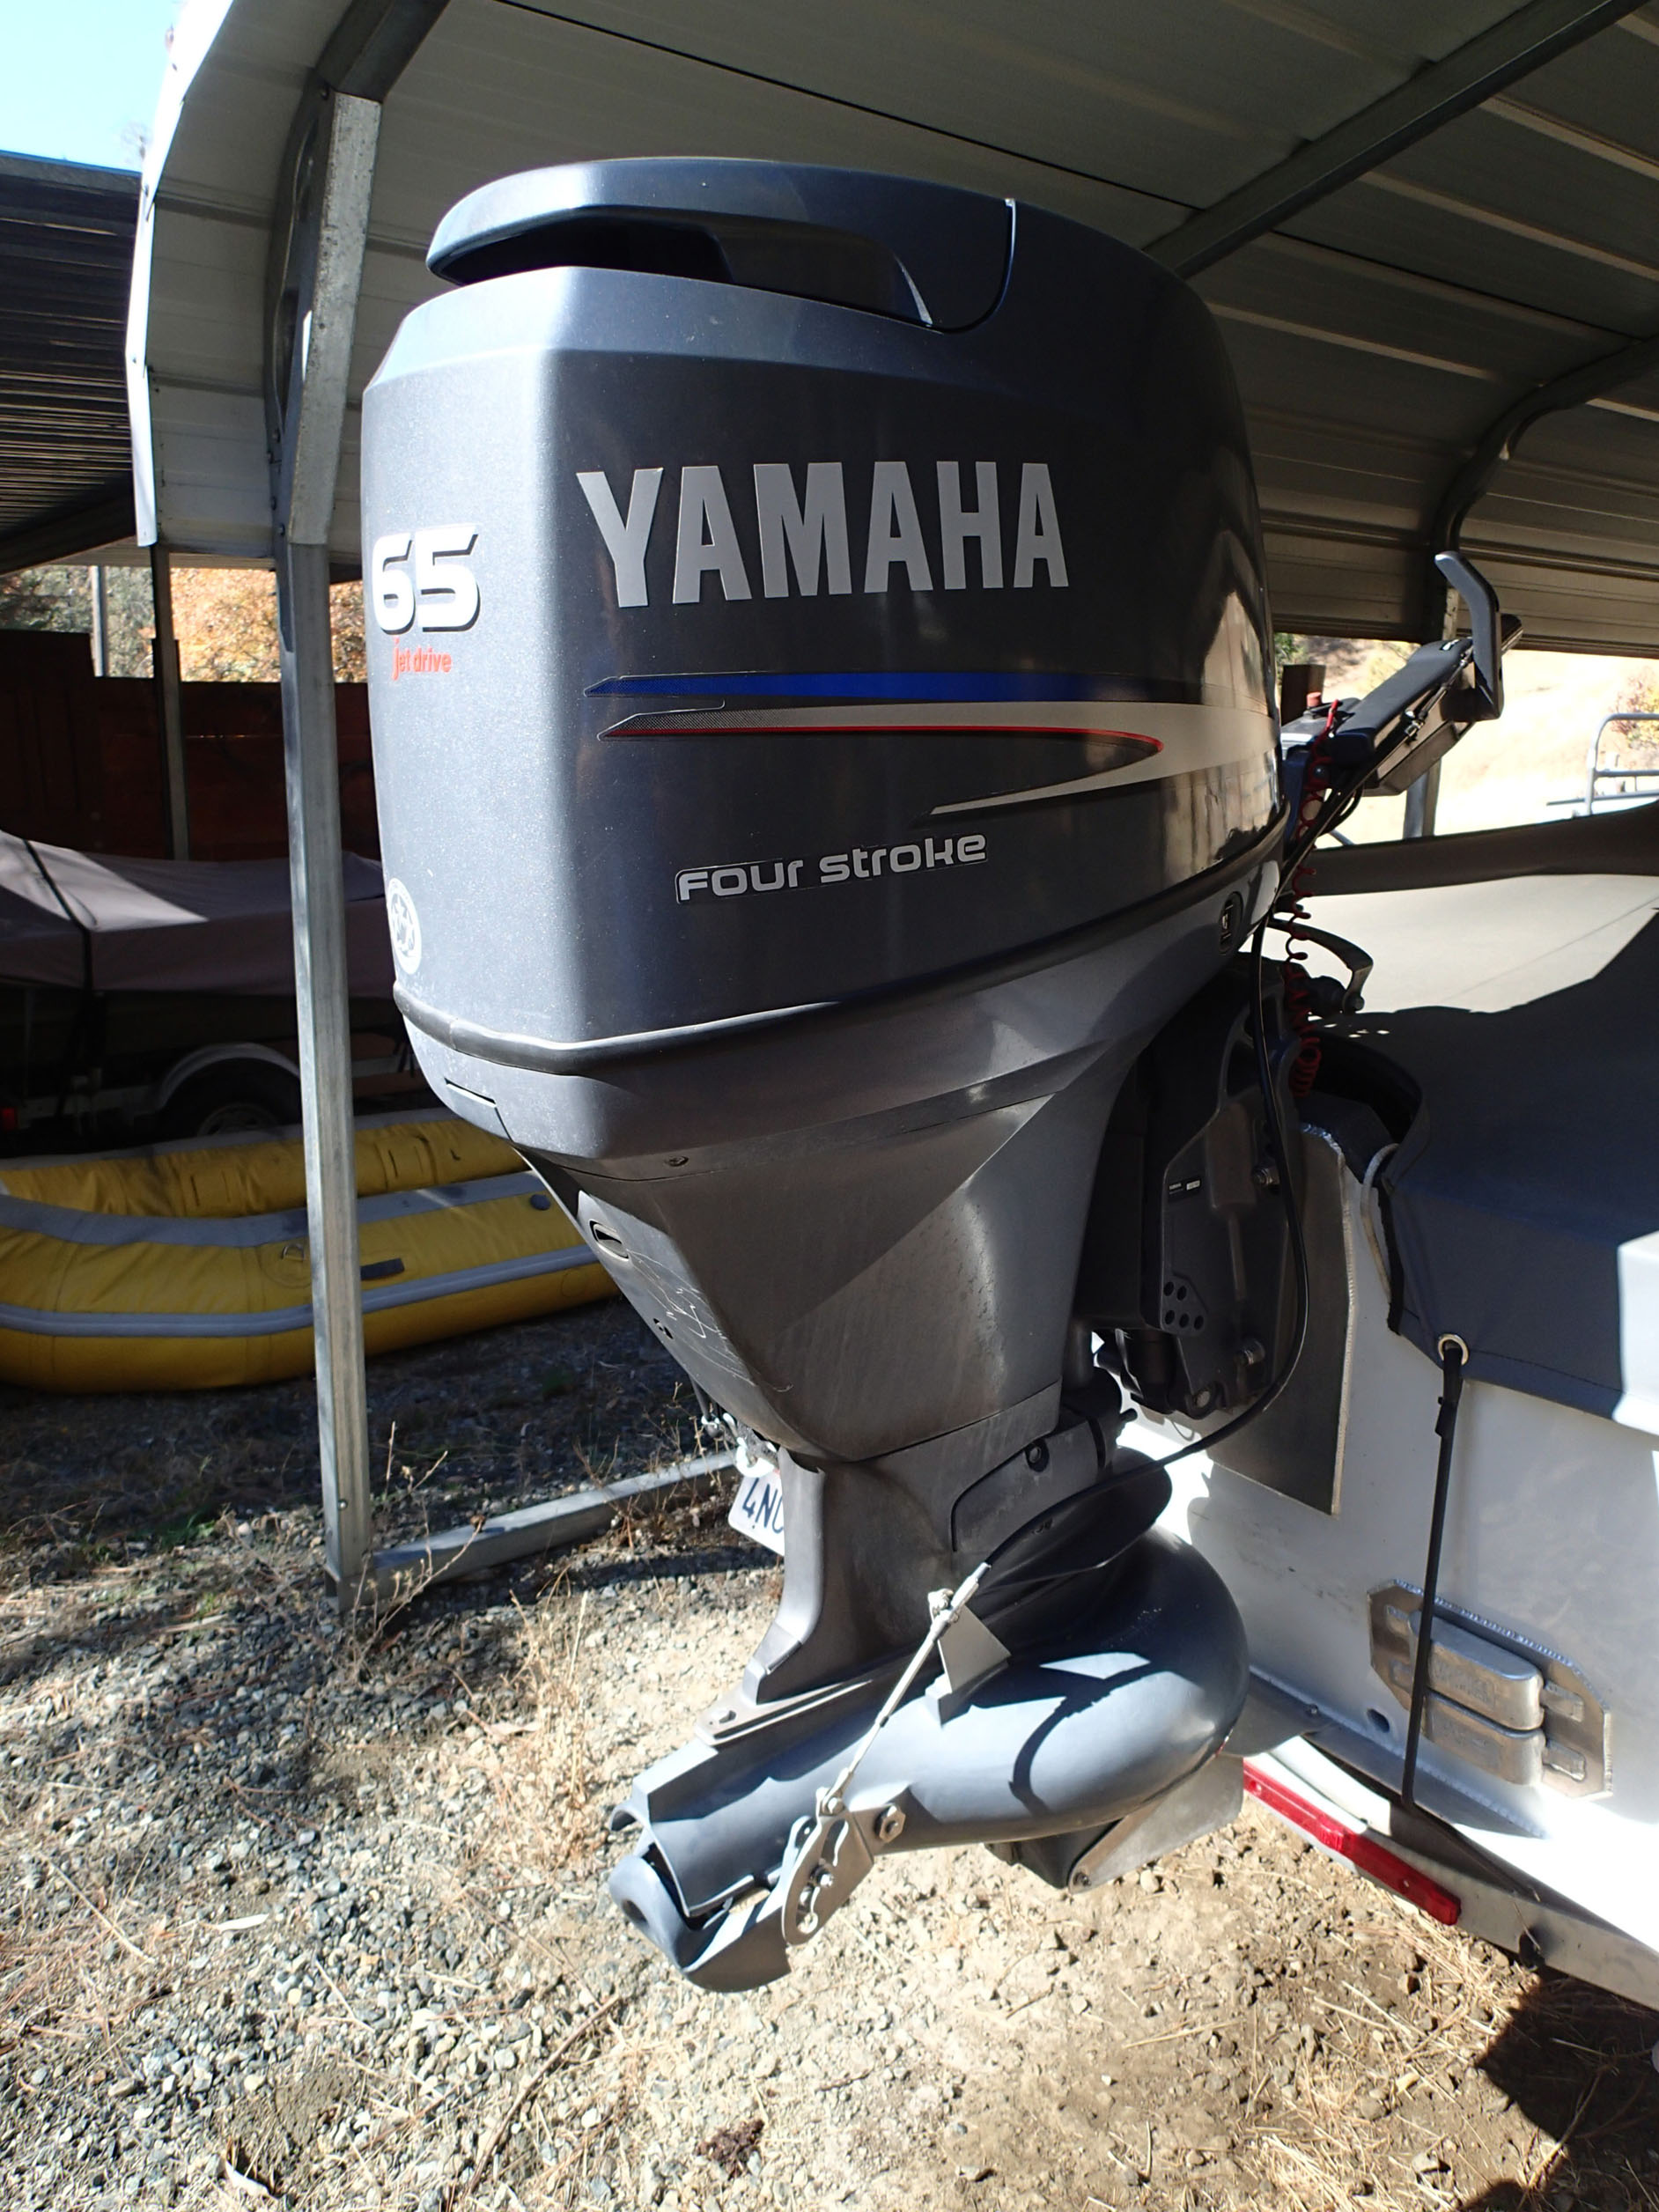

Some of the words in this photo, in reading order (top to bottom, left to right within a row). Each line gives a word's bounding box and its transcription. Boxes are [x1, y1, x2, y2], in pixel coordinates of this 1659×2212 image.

[372, 523, 482, 636] 65
[576, 461, 1069, 608] YAMAHA
[392, 636, 411, 682] jet
[414, 645, 453, 674] drive
